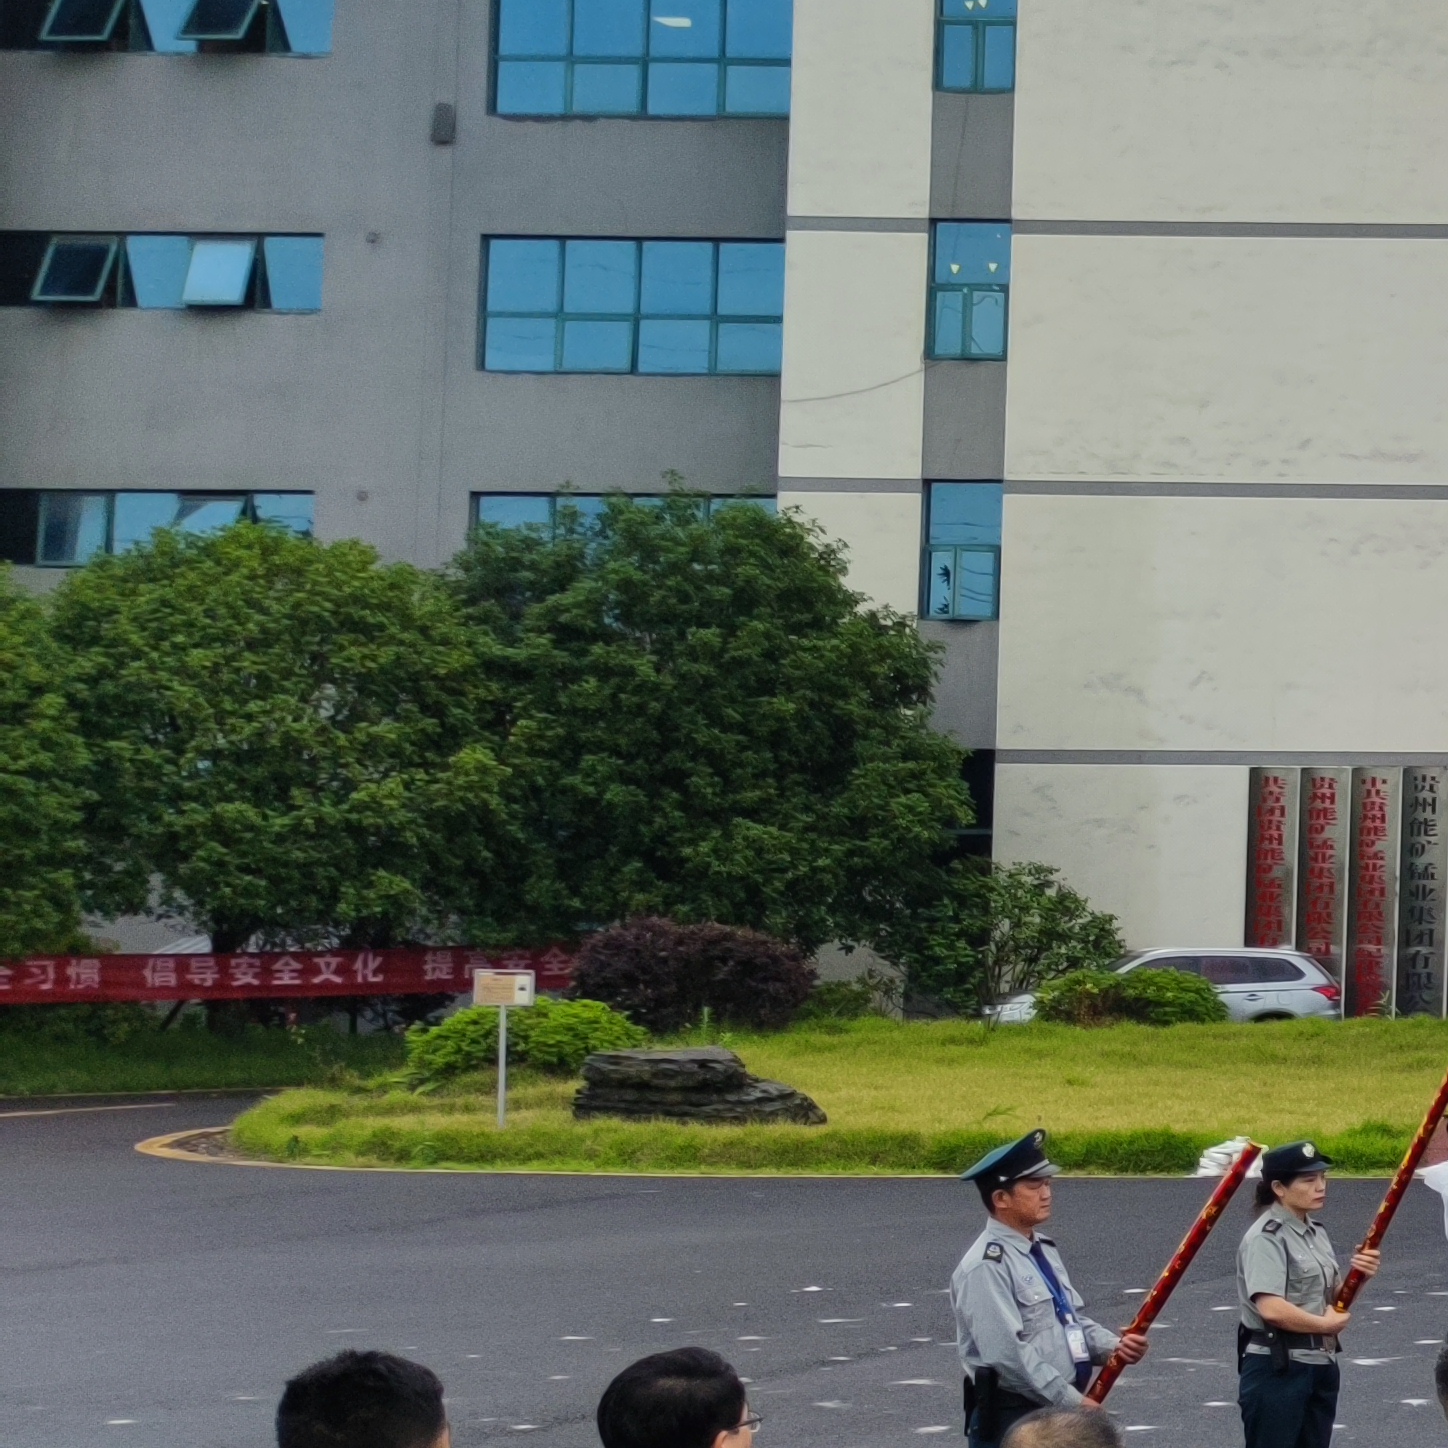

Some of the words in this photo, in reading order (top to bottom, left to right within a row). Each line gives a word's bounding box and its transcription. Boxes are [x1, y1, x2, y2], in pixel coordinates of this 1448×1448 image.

[143, 951, 384, 988] 倡导安全文化
